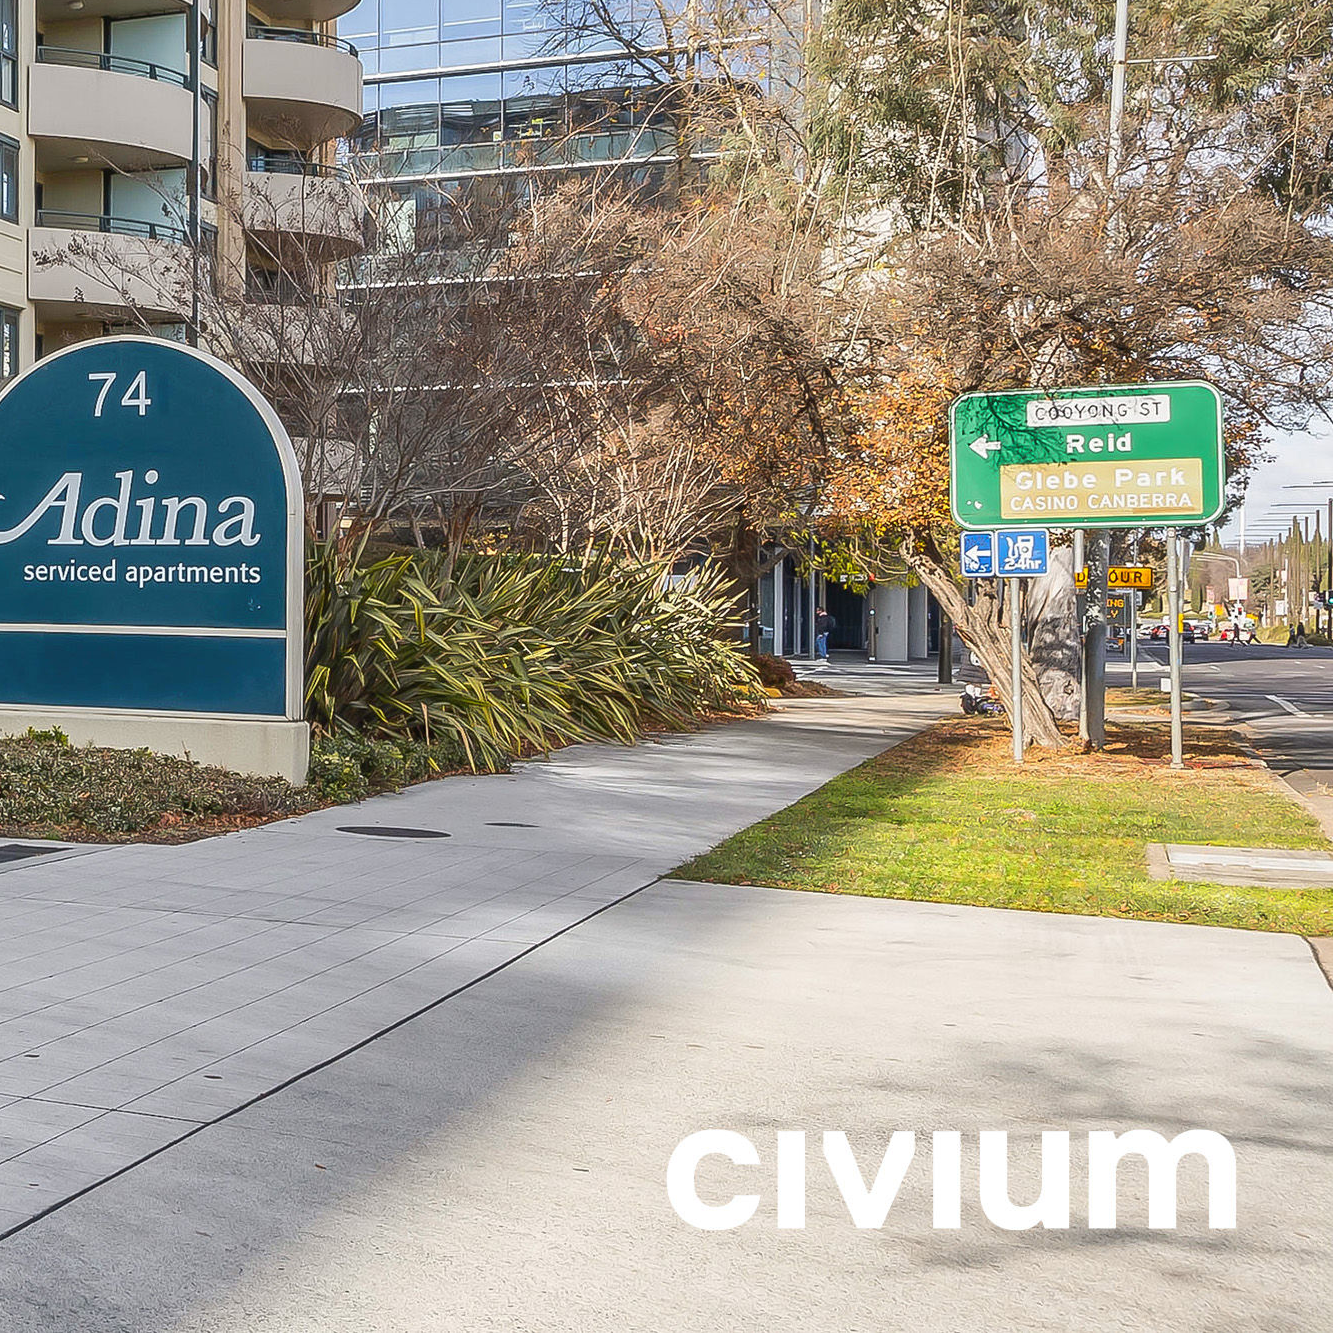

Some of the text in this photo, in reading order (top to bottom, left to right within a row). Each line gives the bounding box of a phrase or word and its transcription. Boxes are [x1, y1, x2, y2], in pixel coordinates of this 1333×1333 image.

[87, 370, 152, 417] 74
[1035, 401, 1162, 421] COOYONG ST
[1065, 431, 1132, 454] Reid
[1015, 467, 1186, 490] Glebe Park
[1010, 492, 1193, 511] CASINO CANBERRA
[23, 559, 261, 588] serviced apartments
[1003, 556, 1042, 571] 24hr
